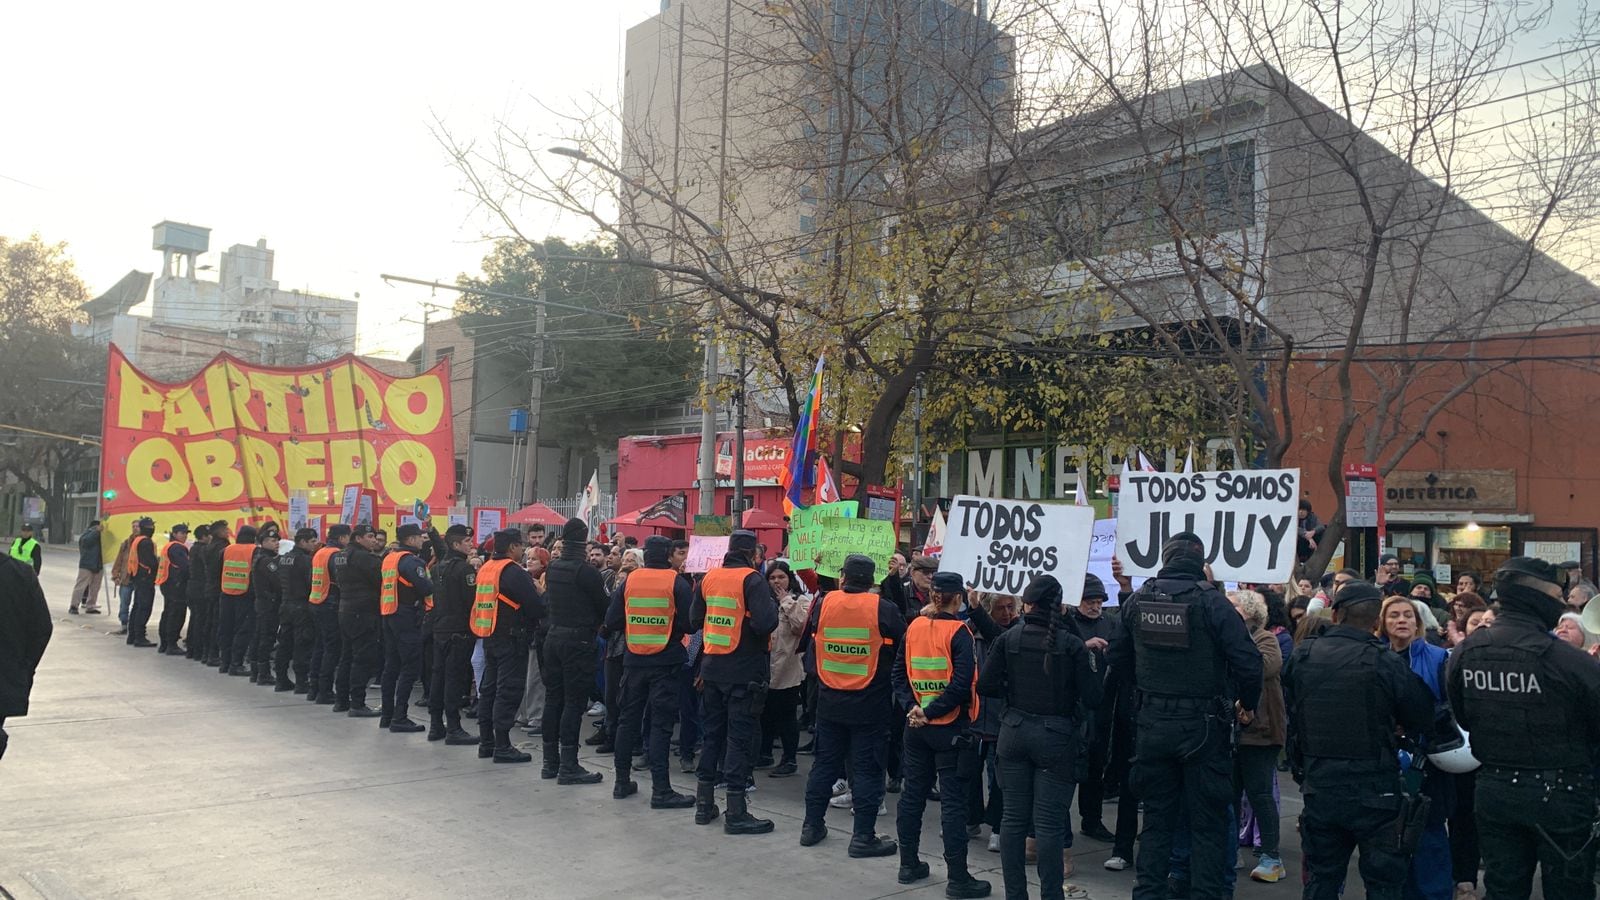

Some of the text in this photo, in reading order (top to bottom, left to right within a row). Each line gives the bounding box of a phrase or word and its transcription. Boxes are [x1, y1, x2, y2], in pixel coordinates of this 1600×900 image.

[118, 362, 444, 436] PARTIDO
[126, 434, 437, 507] OBRERO
[1129, 472, 1295, 503] TODOS SOMOS
[793, 513, 806, 530] EL
[957, 500, 1045, 542] TODOS
[796, 531, 816, 545] VALE
[792, 548, 807, 562] QUE
[987, 541, 1058, 572] SOMOS
[630, 615, 666, 625] POLICIA
[1142, 612, 1184, 627] POLICIA
[827, 643, 868, 655] POLICIA
[1462, 668, 1542, 694] POLICIA
